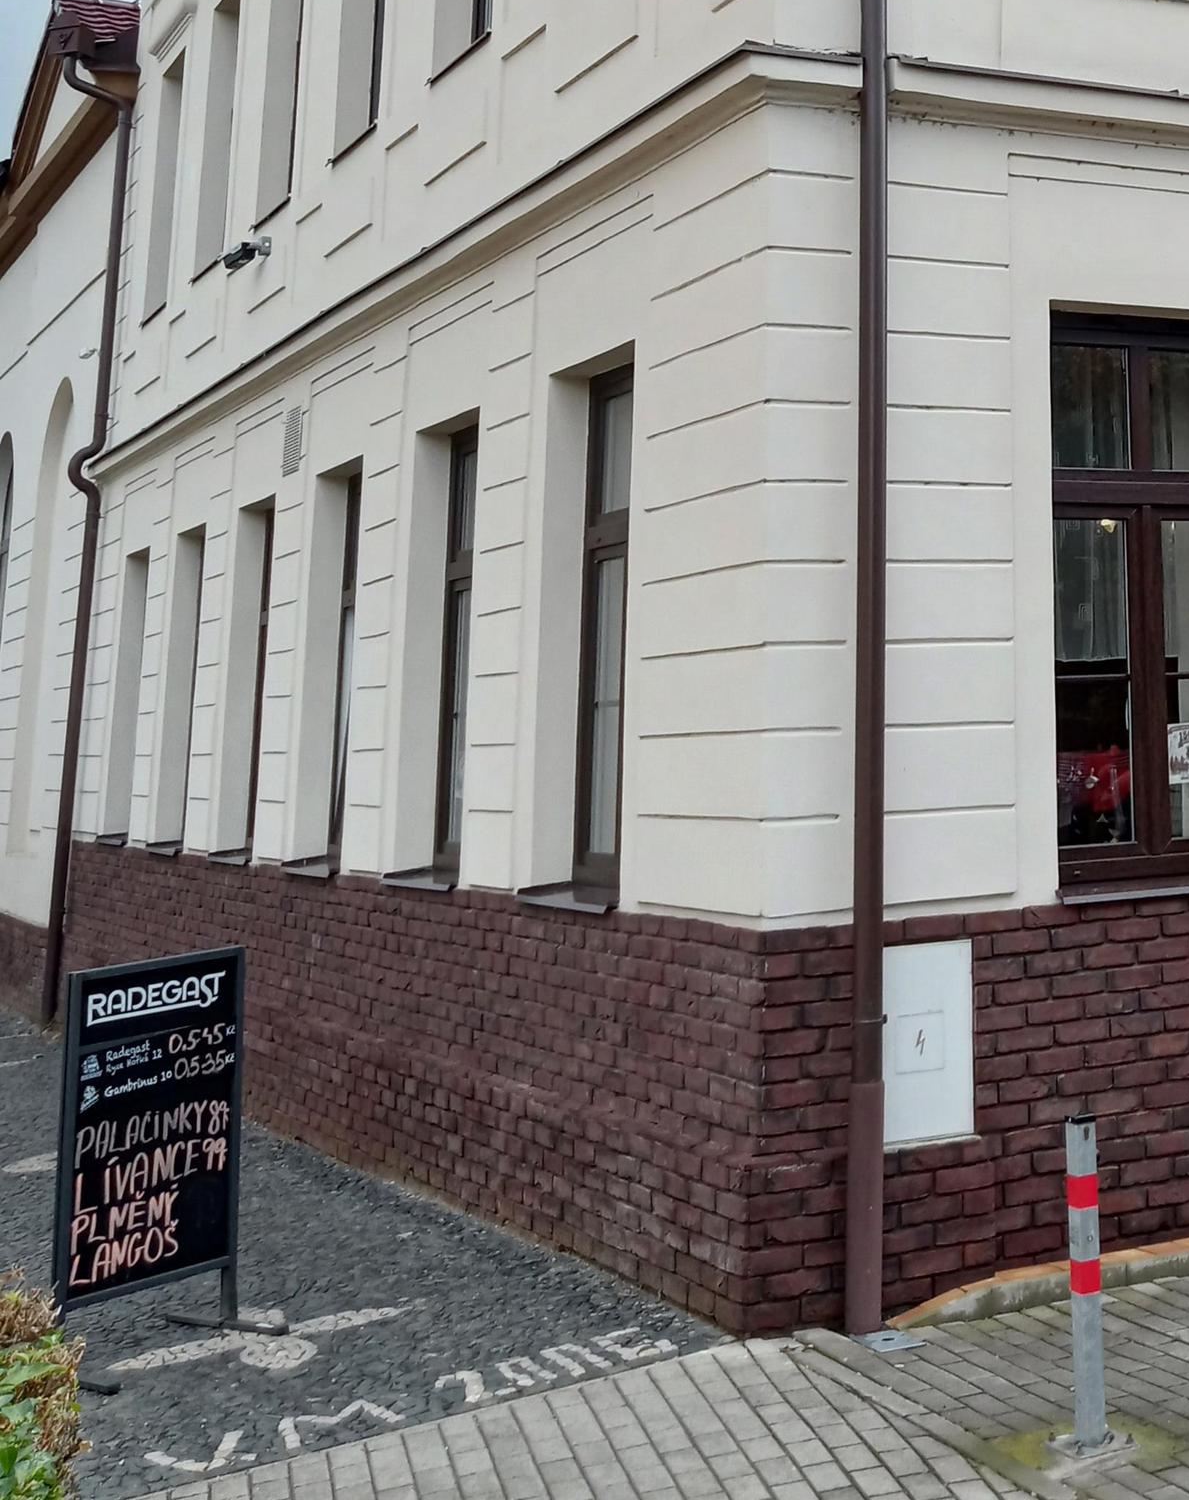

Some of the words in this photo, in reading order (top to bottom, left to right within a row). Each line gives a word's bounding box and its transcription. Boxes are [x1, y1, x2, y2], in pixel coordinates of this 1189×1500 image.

[86, 970, 227, 1028] RADEGAST
[105, 1039, 151, 1062] Radegast
[152, 1048, 163, 1060] 12
[104, 1075, 159, 1098] Gambrinus
[160, 1070, 173, 1082] 10
[68, 1218, 180, 1287] LANGOŠ
